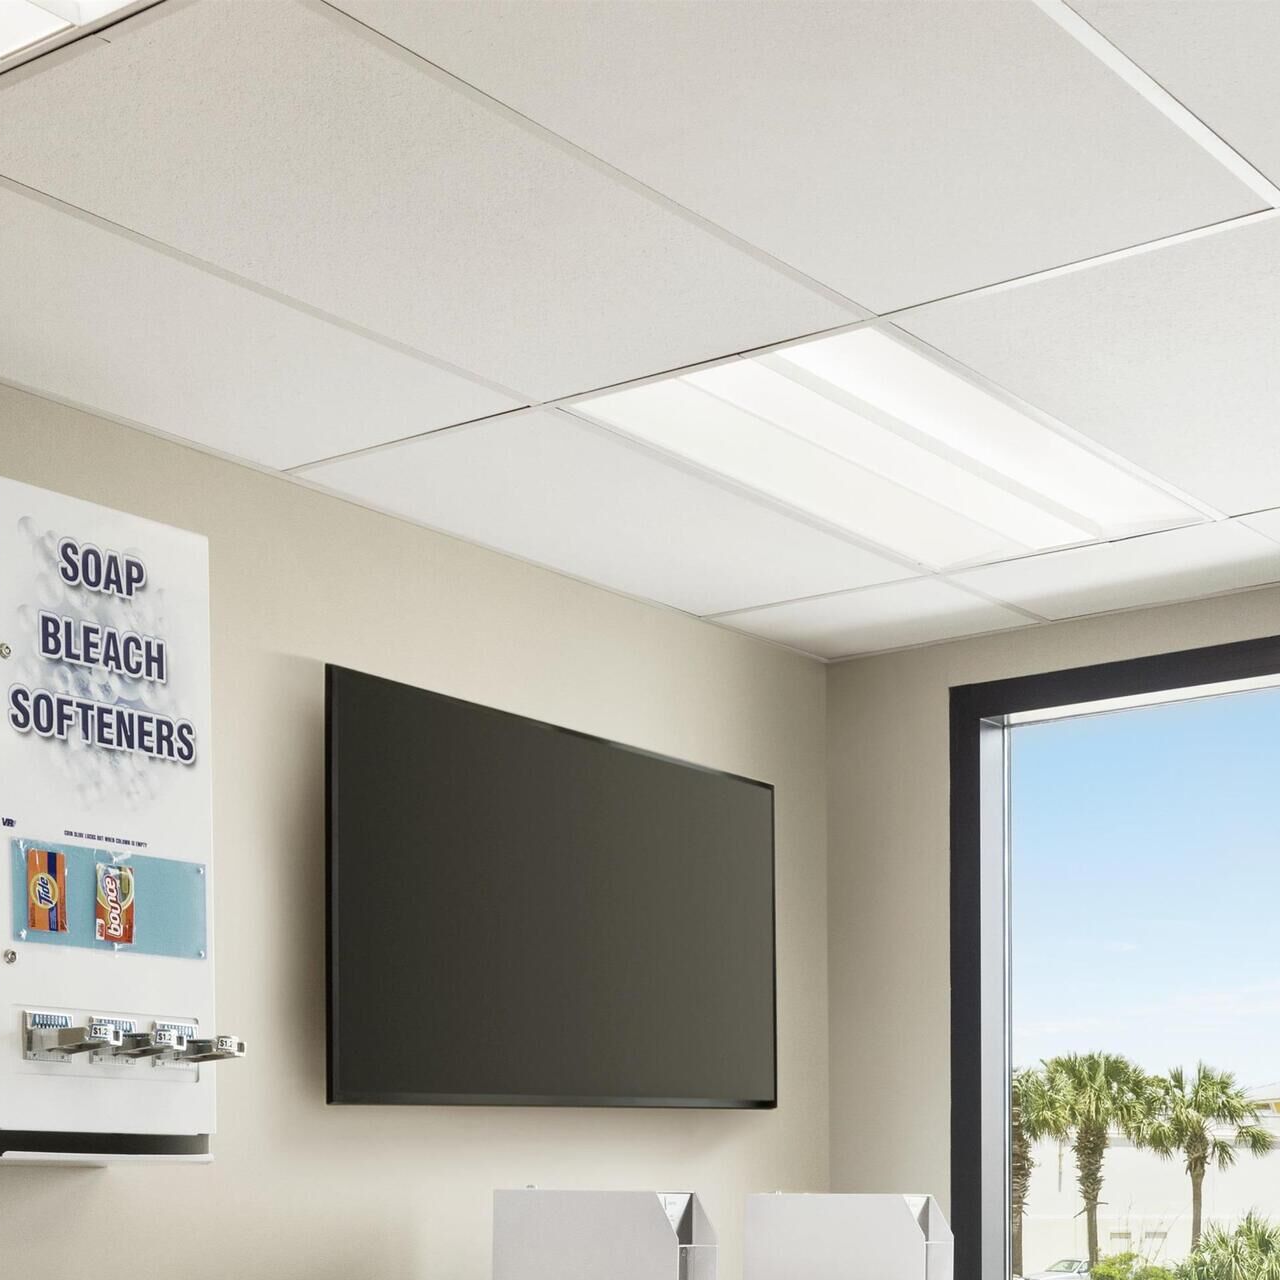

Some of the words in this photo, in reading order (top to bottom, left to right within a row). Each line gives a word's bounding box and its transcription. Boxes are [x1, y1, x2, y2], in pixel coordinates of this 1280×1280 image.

[59, 539, 145, 599] SOAP
[39, 612, 166, 683] BLEACH
[9, 685, 196, 764] SOFTENERS
[37, 876, 55, 907] Tide
[105, 874, 124, 937] bounce
[93, 1027, 108, 1036] $1.2
[158, 1033, 172, 1041] $1.2
[219, 1039, 233, 1048] $1.2
